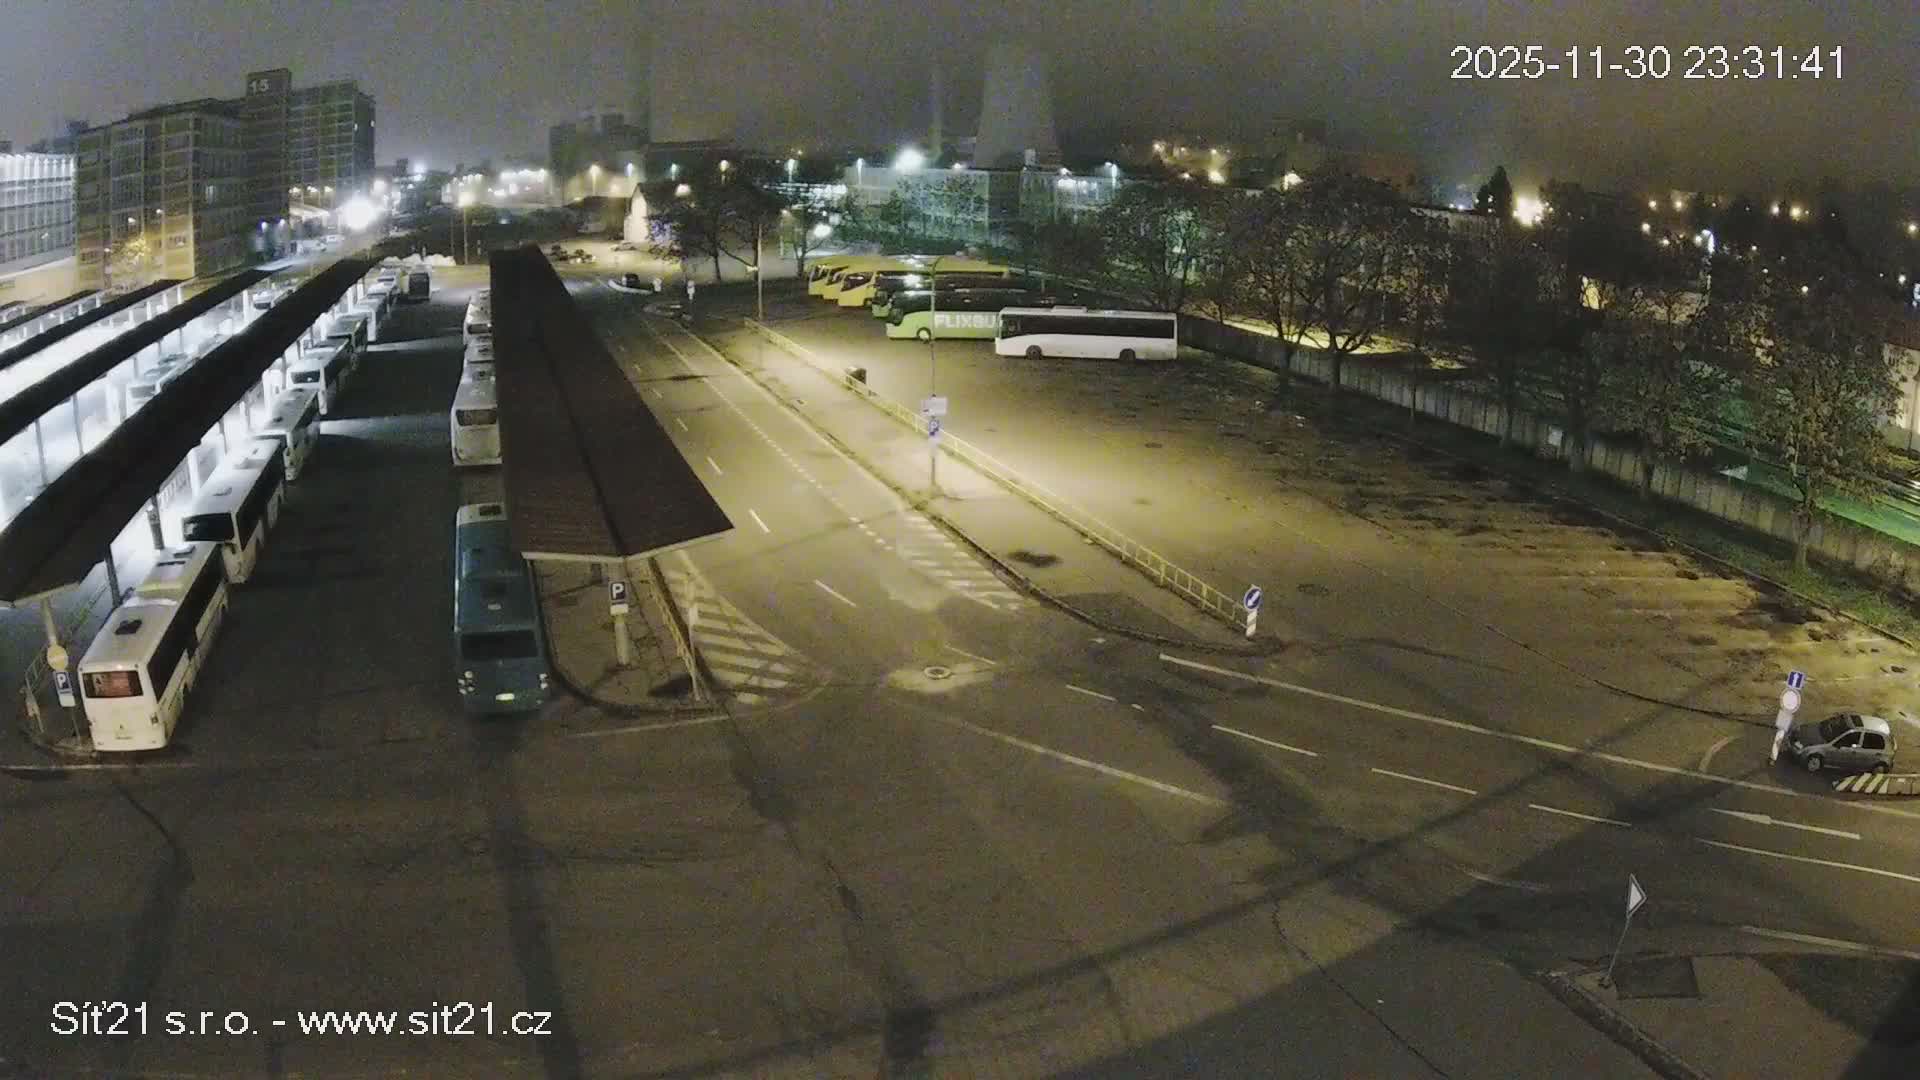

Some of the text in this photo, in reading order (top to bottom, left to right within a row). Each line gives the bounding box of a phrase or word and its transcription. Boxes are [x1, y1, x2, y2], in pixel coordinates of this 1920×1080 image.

[934, 313, 997, 329] FLIXBU
[612, 583, 624, 599] P
[57, 673, 67, 688] P
